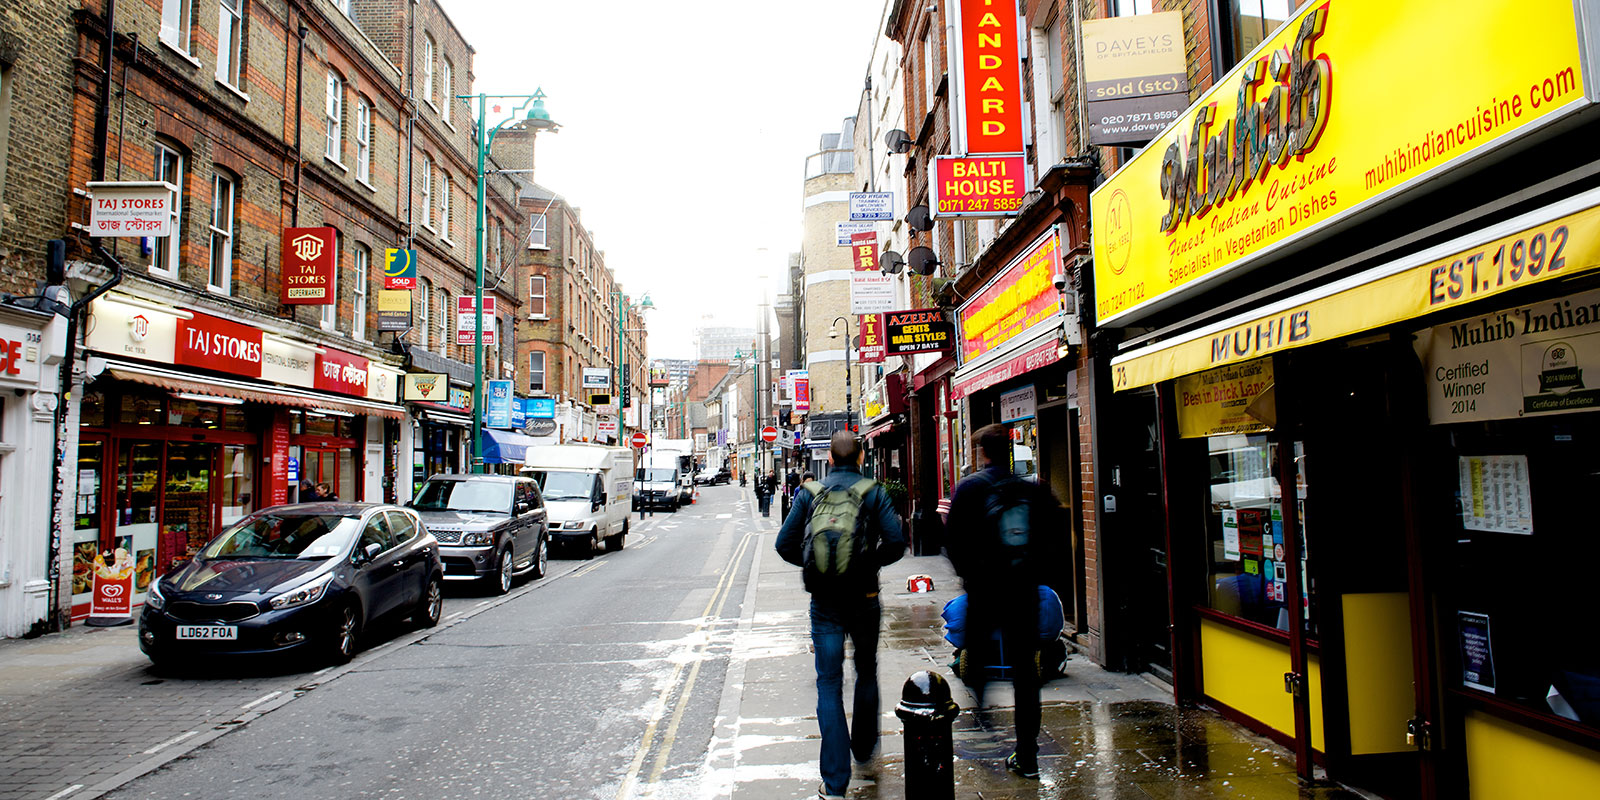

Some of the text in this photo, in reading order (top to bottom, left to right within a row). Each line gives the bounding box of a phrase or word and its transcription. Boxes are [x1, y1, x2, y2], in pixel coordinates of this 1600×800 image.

[1096, 34, 1173, 54] DAVEYS
[1112, 47, 1173, 58] SPITALFIELDS
[1096, 77, 1179, 97] sold (stc)
[1101, 110, 1178, 125] 020 7871 9599
[1159, 7, 1330, 234] Muhib
[1365, 66, 1576, 190] muhibindiancuisine com
[953, 160, 1007, 178] BALTI
[945, 179, 1015, 196] HOUSE
[97, 199, 164, 210] TAJ STORES
[938, 198, 1023, 212] 0171 247 5855
[1168, 157, 1337, 264] Finest Indian Cuisine
[97, 220, 121, 231] তাজ
[1168, 189, 1337, 286] Specialist In Vegetarian Dishes
[300, 265, 316, 275] TAJ
[1429, 224, 1569, 306] EST.1992
[288, 275, 326, 285] STORES
[289, 288, 324, 297] SUPERMARKET
[1111, 290, 1126, 310] 7247
[1128, 281, 1145, 304] 7122
[889, 312, 943, 326] AZEEM
[902, 324, 930, 334] GENTS
[1211, 310, 1310, 363] MUHIB
[1450, 313, 1515, 349] Muhib
[187, 327, 261, 363] TAJ STORES
[892, 332, 946, 345] HAIR STYLES
[1116, 366, 1127, 388] 73
[1203, 363, 1263, 386] Muhib Indian Cuisine
[1435, 360, 1489, 382] Certified
[1545, 372, 1577, 384] 2014 Winner
[1183, 391, 1202, 407] Best
[1203, 389, 1212, 403] in
[1213, 383, 1239, 401] Brick
[1443, 381, 1486, 398] Winner
[1452, 399, 1476, 414] 2014
[1532, 396, 1594, 409] Certificate of Excellence
[181, 627, 233, 638] LD62 FOA
